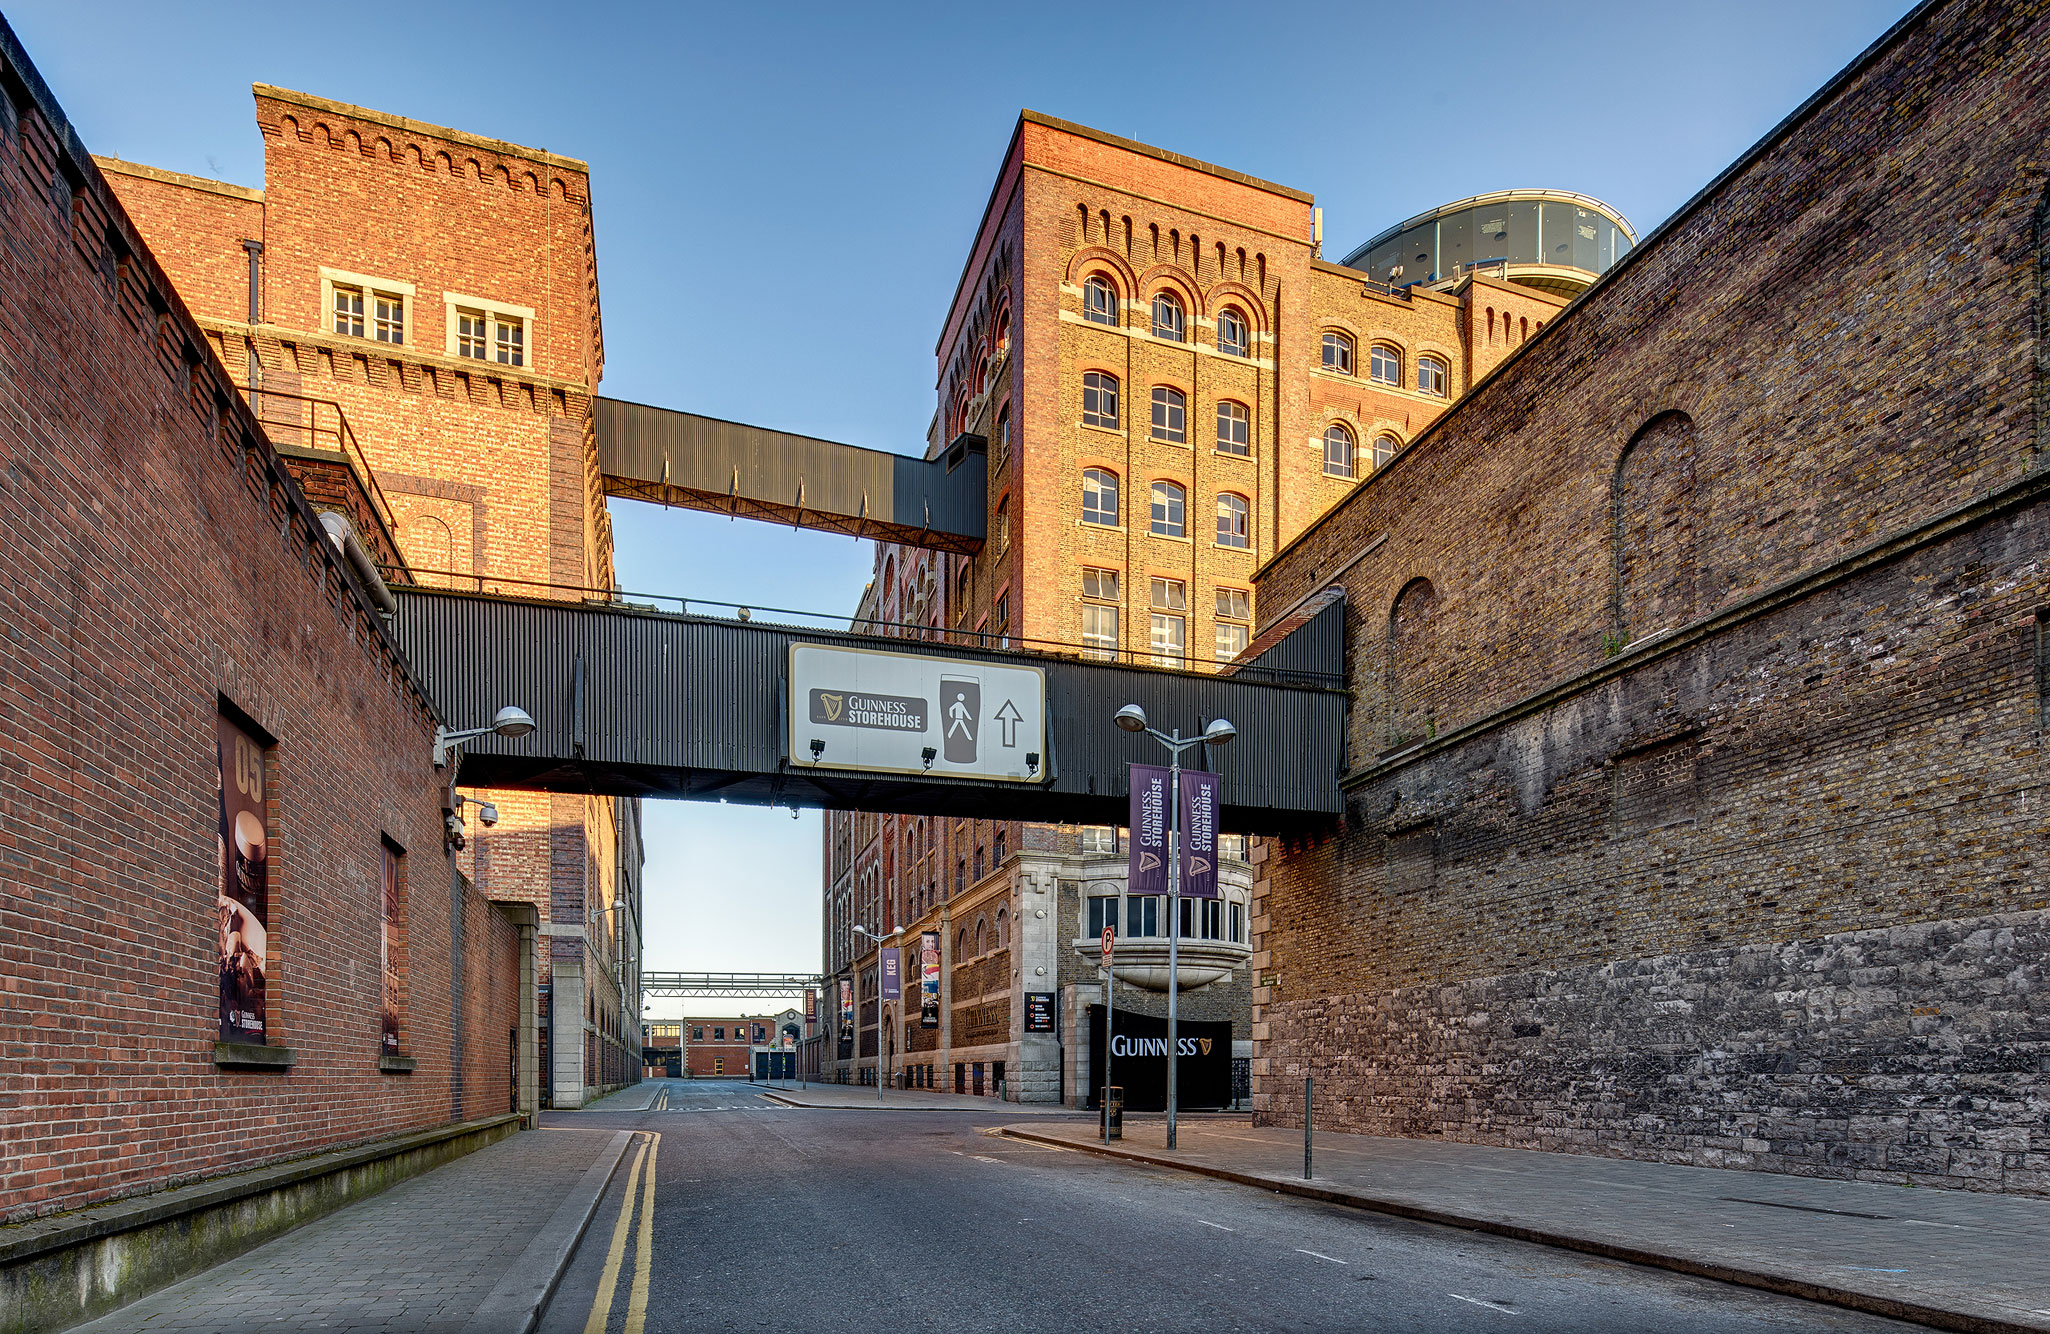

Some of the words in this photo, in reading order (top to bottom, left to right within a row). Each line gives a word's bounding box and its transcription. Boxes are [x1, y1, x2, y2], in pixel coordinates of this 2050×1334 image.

[848, 695, 907, 714] GUINNESS
[848, 710, 921, 729] STOREHOUSE
[235, 734, 262, 803] 05
[1140, 791, 1152, 847] GUINNESS
[1151, 777, 1163, 848] STOREHOUSE
[1190, 796, 1202, 851] GUINNESS
[1200, 783, 1212, 852] STOREHOUSE
[886, 959, 897, 976] KEG
[1111, 1034, 1197, 1057] GUINNSS
